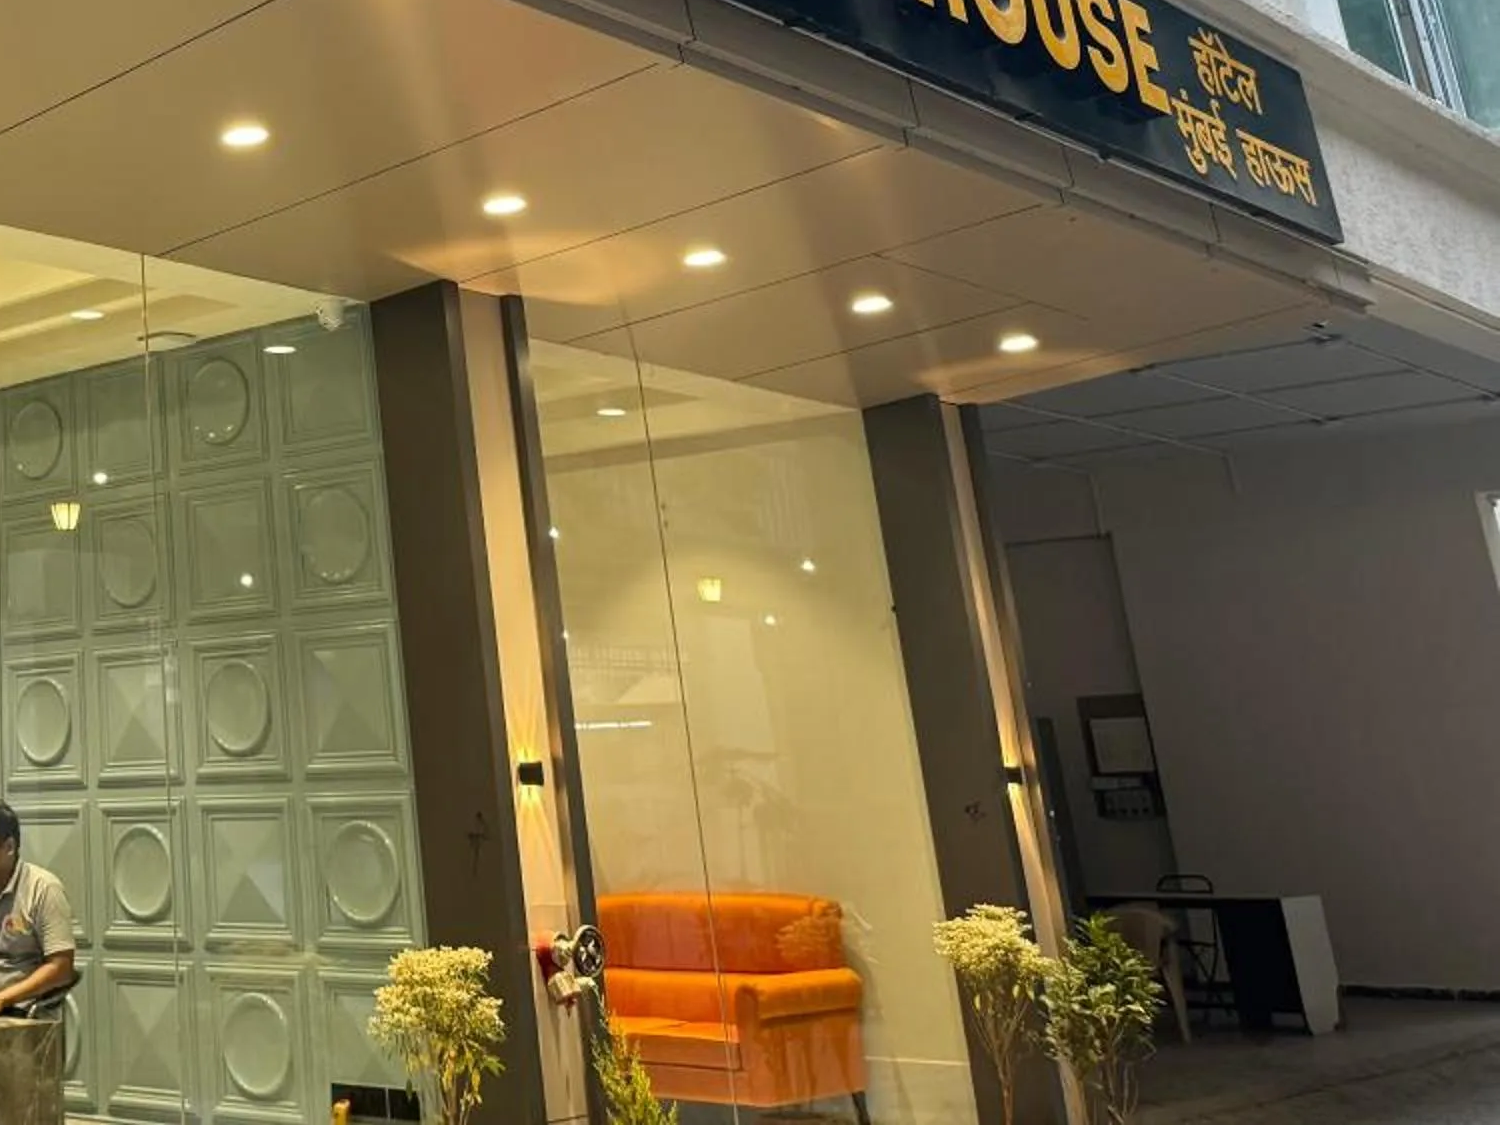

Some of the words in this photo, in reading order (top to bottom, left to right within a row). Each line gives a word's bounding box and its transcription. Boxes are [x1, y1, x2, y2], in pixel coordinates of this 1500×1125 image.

[1188, 27, 1263, 115] हॉटेल
[1171, 88, 1237, 180] मुंबई
[1235, 128, 1317, 206] हाऊस
